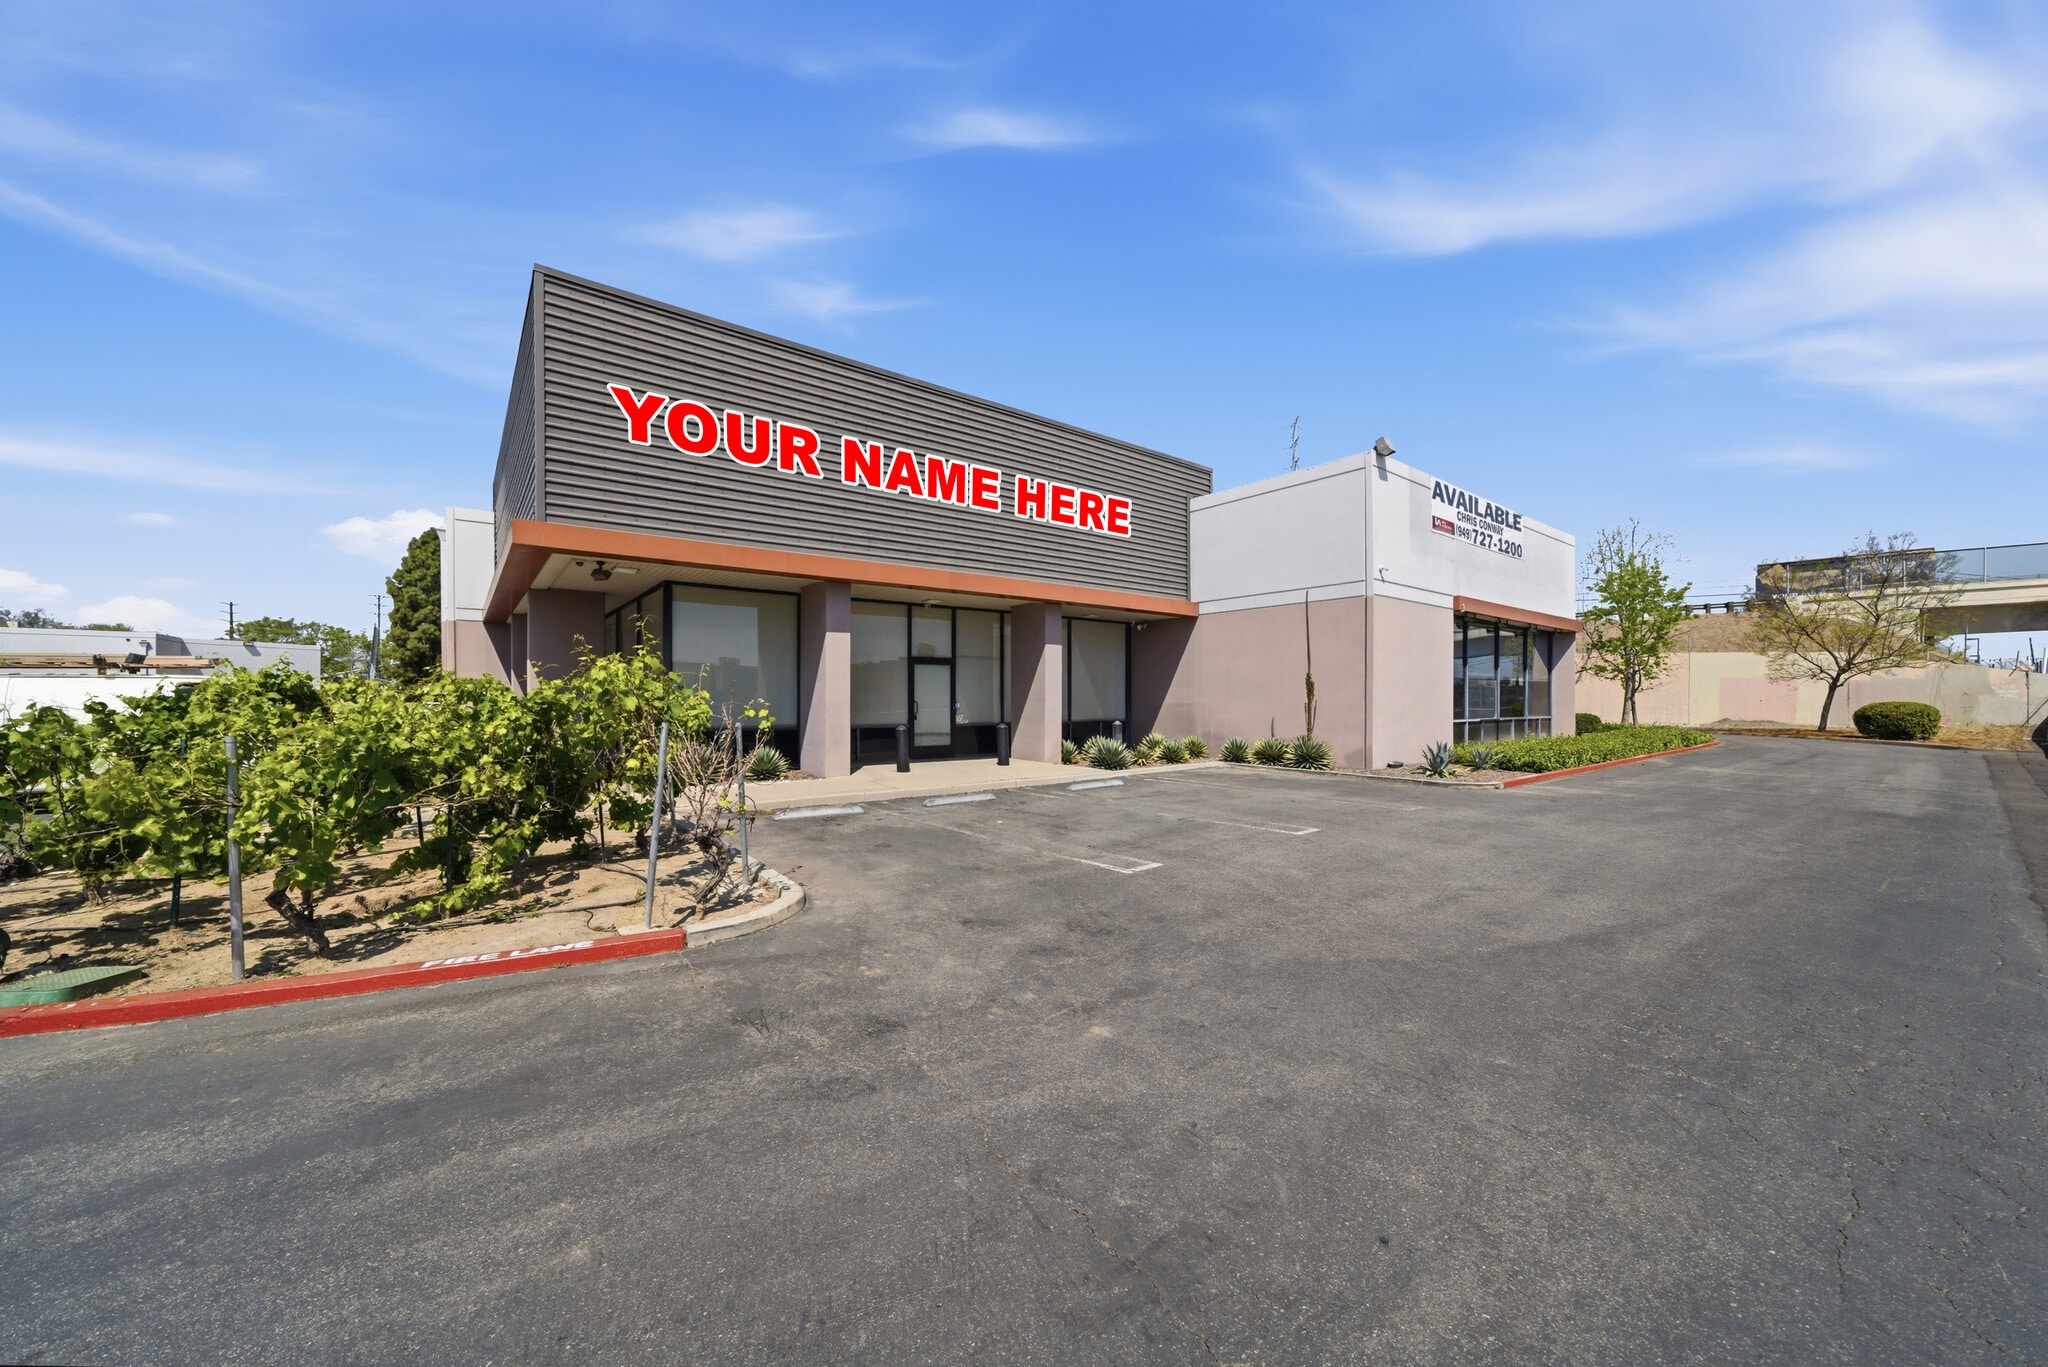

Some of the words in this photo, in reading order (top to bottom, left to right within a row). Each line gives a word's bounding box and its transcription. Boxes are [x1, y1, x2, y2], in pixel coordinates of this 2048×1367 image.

[1432, 480, 1522, 532] AVAILABLE
[1456, 511, 1478, 527] CHRIS
[1478, 519, 1504, 536] CONWAY
[1472, 529, 1523, 558] 727-1200
[420, 953, 500, 968] FIRE
[510, 941, 594, 957] LANE
